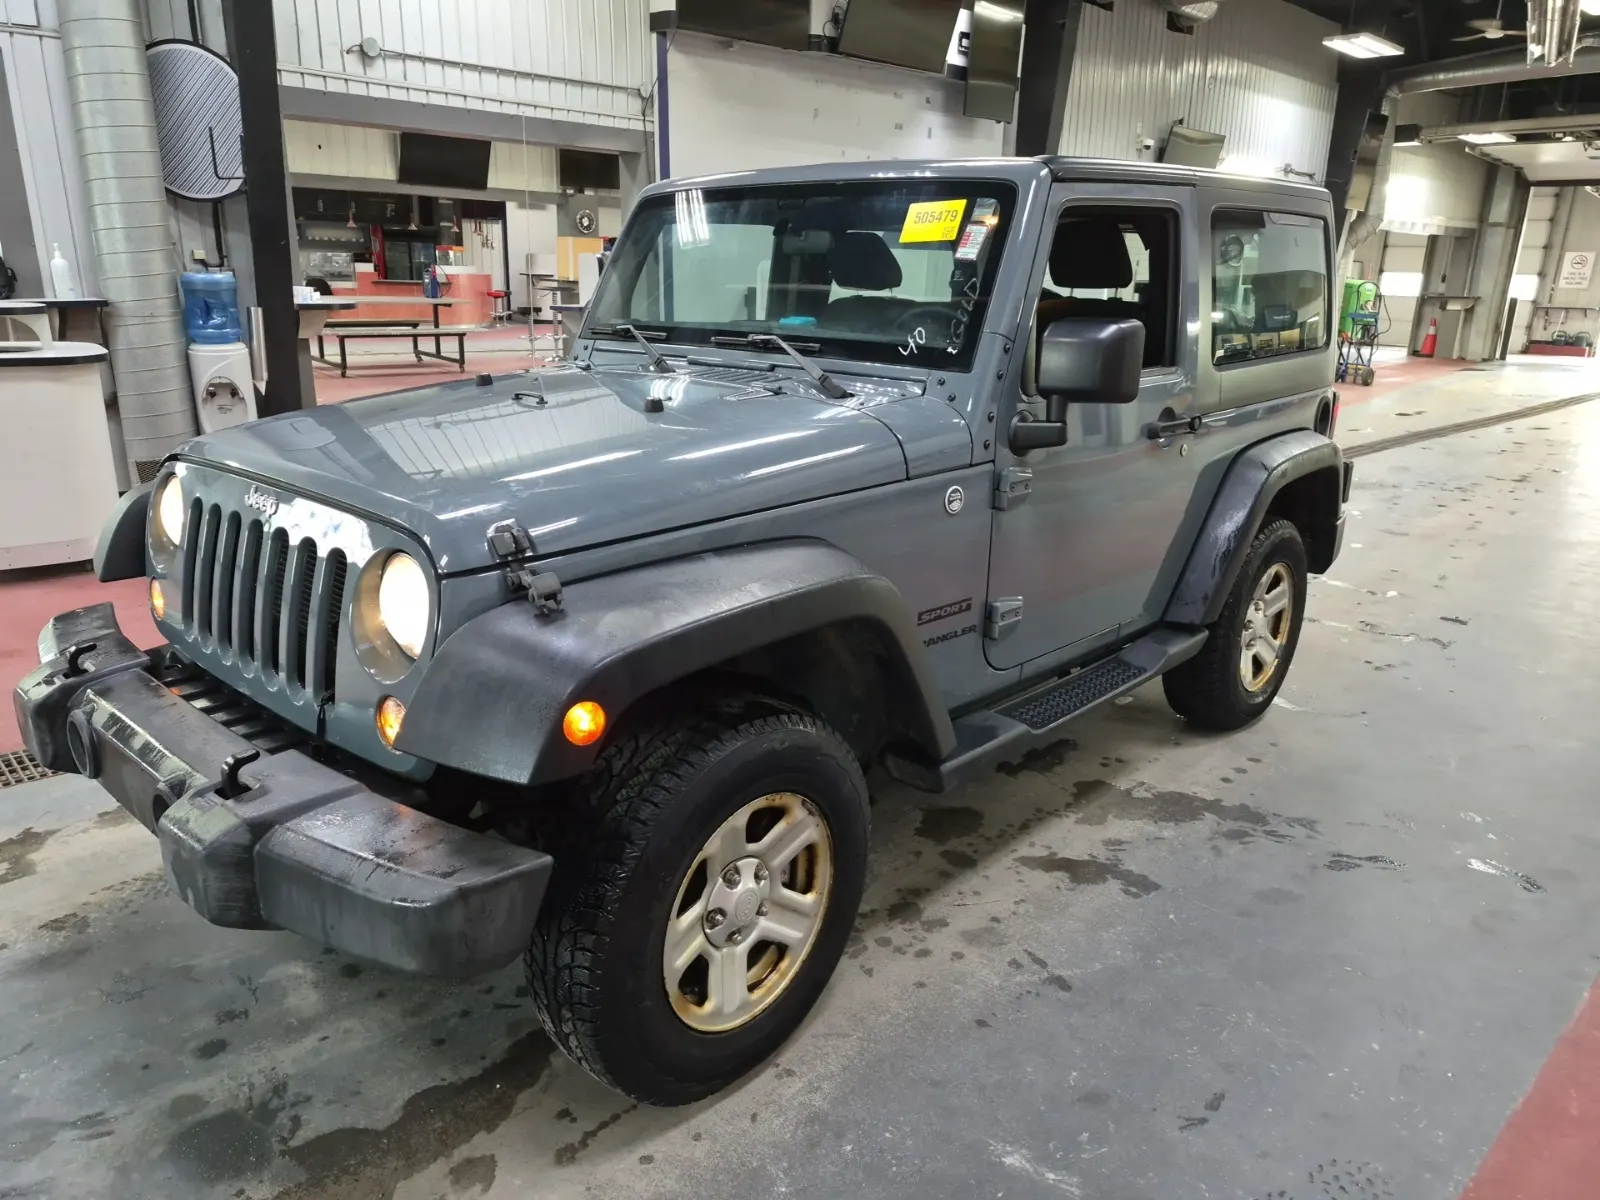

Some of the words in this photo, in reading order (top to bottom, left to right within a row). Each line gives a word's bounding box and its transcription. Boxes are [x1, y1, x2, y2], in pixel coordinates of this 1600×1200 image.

[914, 209, 959, 225] 505479
[244, 484, 280, 519] Jeep
[918, 600, 971, 623] SPORT
